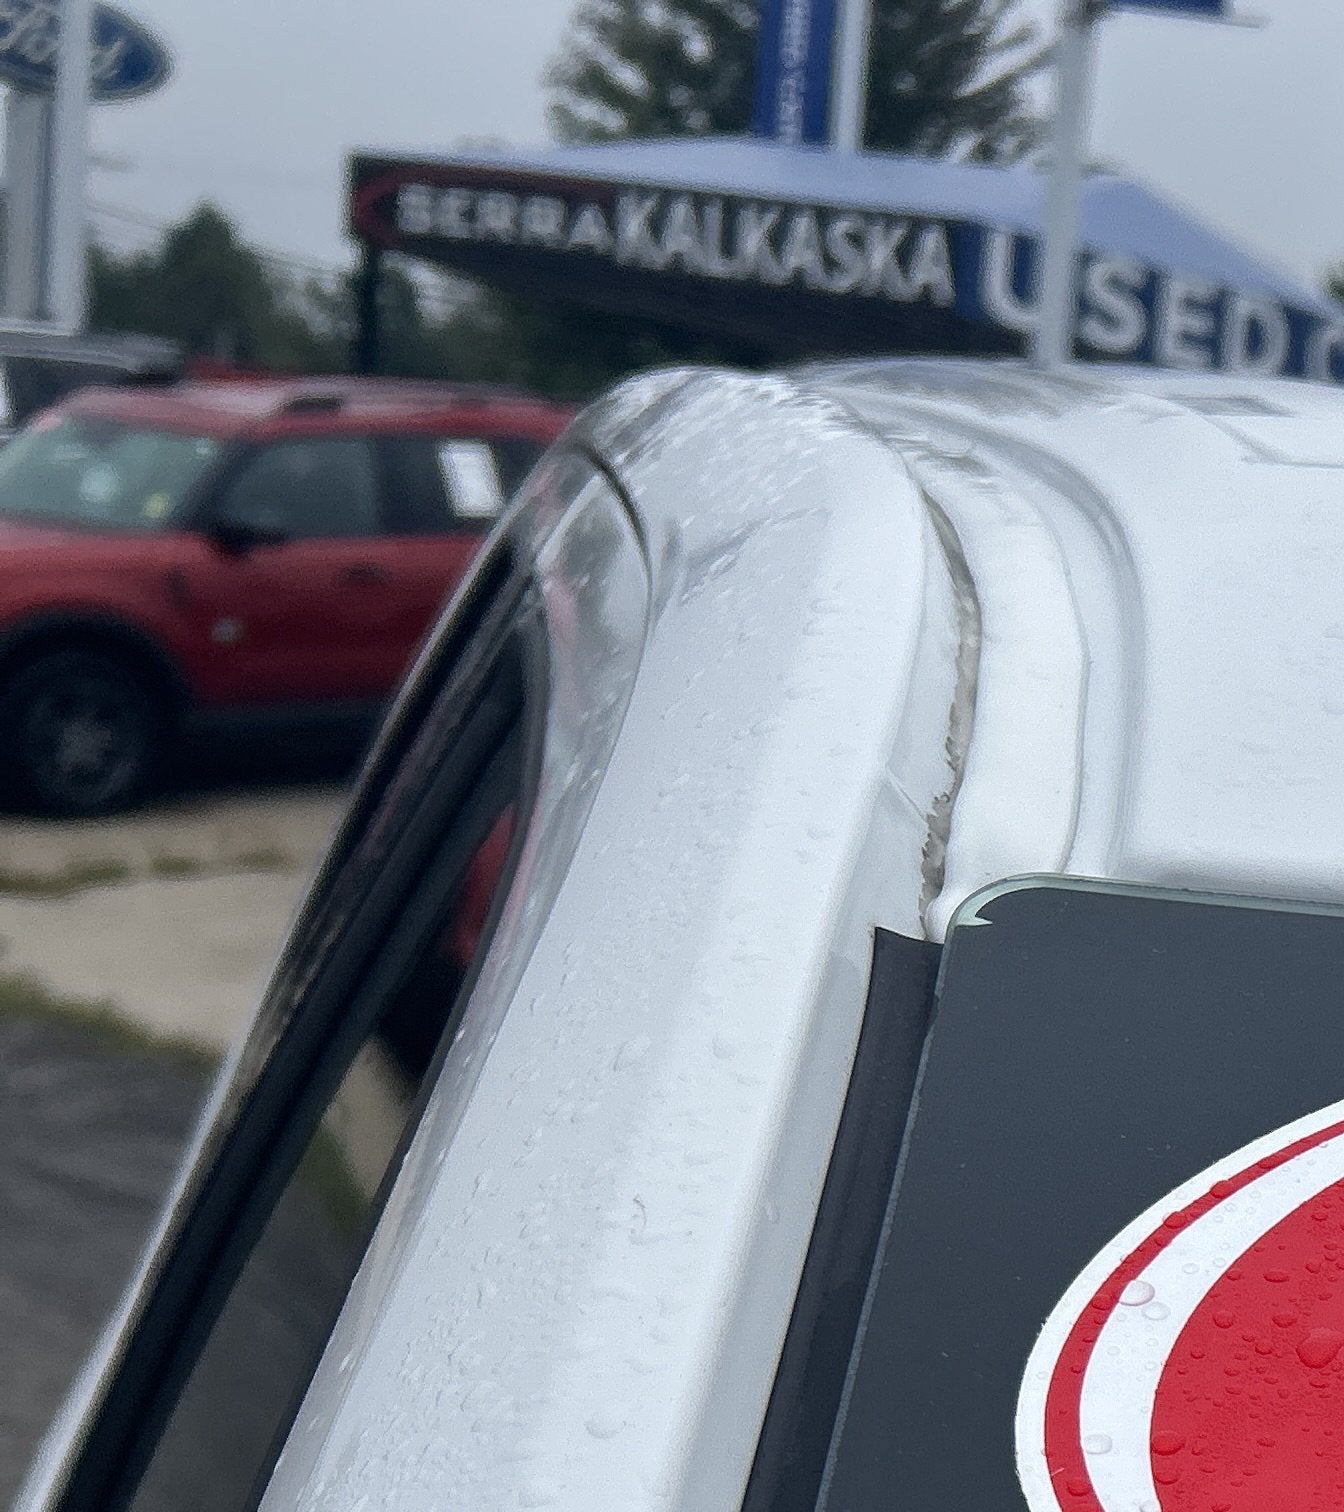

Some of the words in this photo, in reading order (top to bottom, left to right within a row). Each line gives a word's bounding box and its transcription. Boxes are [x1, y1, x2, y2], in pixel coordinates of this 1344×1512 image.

[398, 183, 615, 252] SERRA
[614, 193, 957, 307] KALKASKA
[984, 228, 1290, 376] USED
